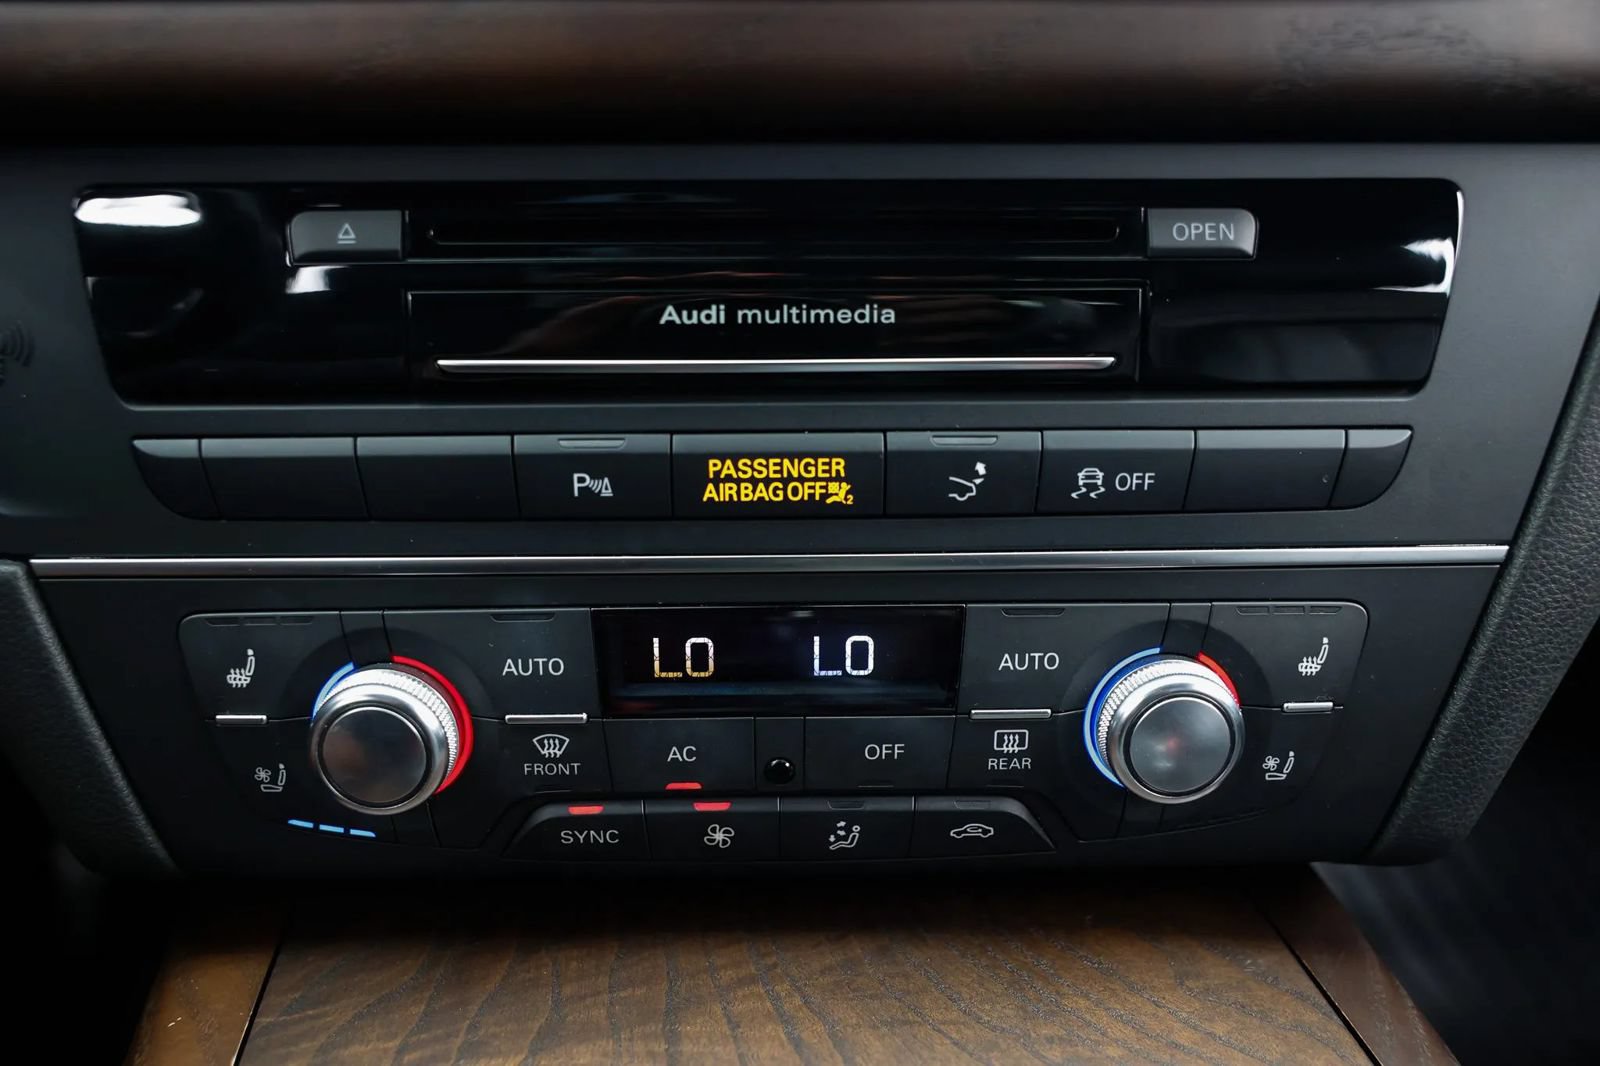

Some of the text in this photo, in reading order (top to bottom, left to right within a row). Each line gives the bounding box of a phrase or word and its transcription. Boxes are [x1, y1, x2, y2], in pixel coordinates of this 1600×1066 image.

[1172, 222, 1234, 241] OPEN
[660, 303, 896, 325] Audi multimedia
[708, 457, 846, 479] PASSENGER
[1116, 472, 1156, 491] OFF
[702, 482, 784, 502] AIRBAG
[787, 481, 827, 501] OFF
[653, 637, 715, 678] LO
[813, 636, 875, 677] LO
[998, 652, 1060, 671] AUTO
[502, 657, 565, 677] AUTO
[666, 745, 697, 762] AC
[864, 743, 905, 760] OFF
[523, 762, 581, 776] FRONT
[987, 757, 1032, 771] REAR
[560, 829, 620, 844] SYNC
